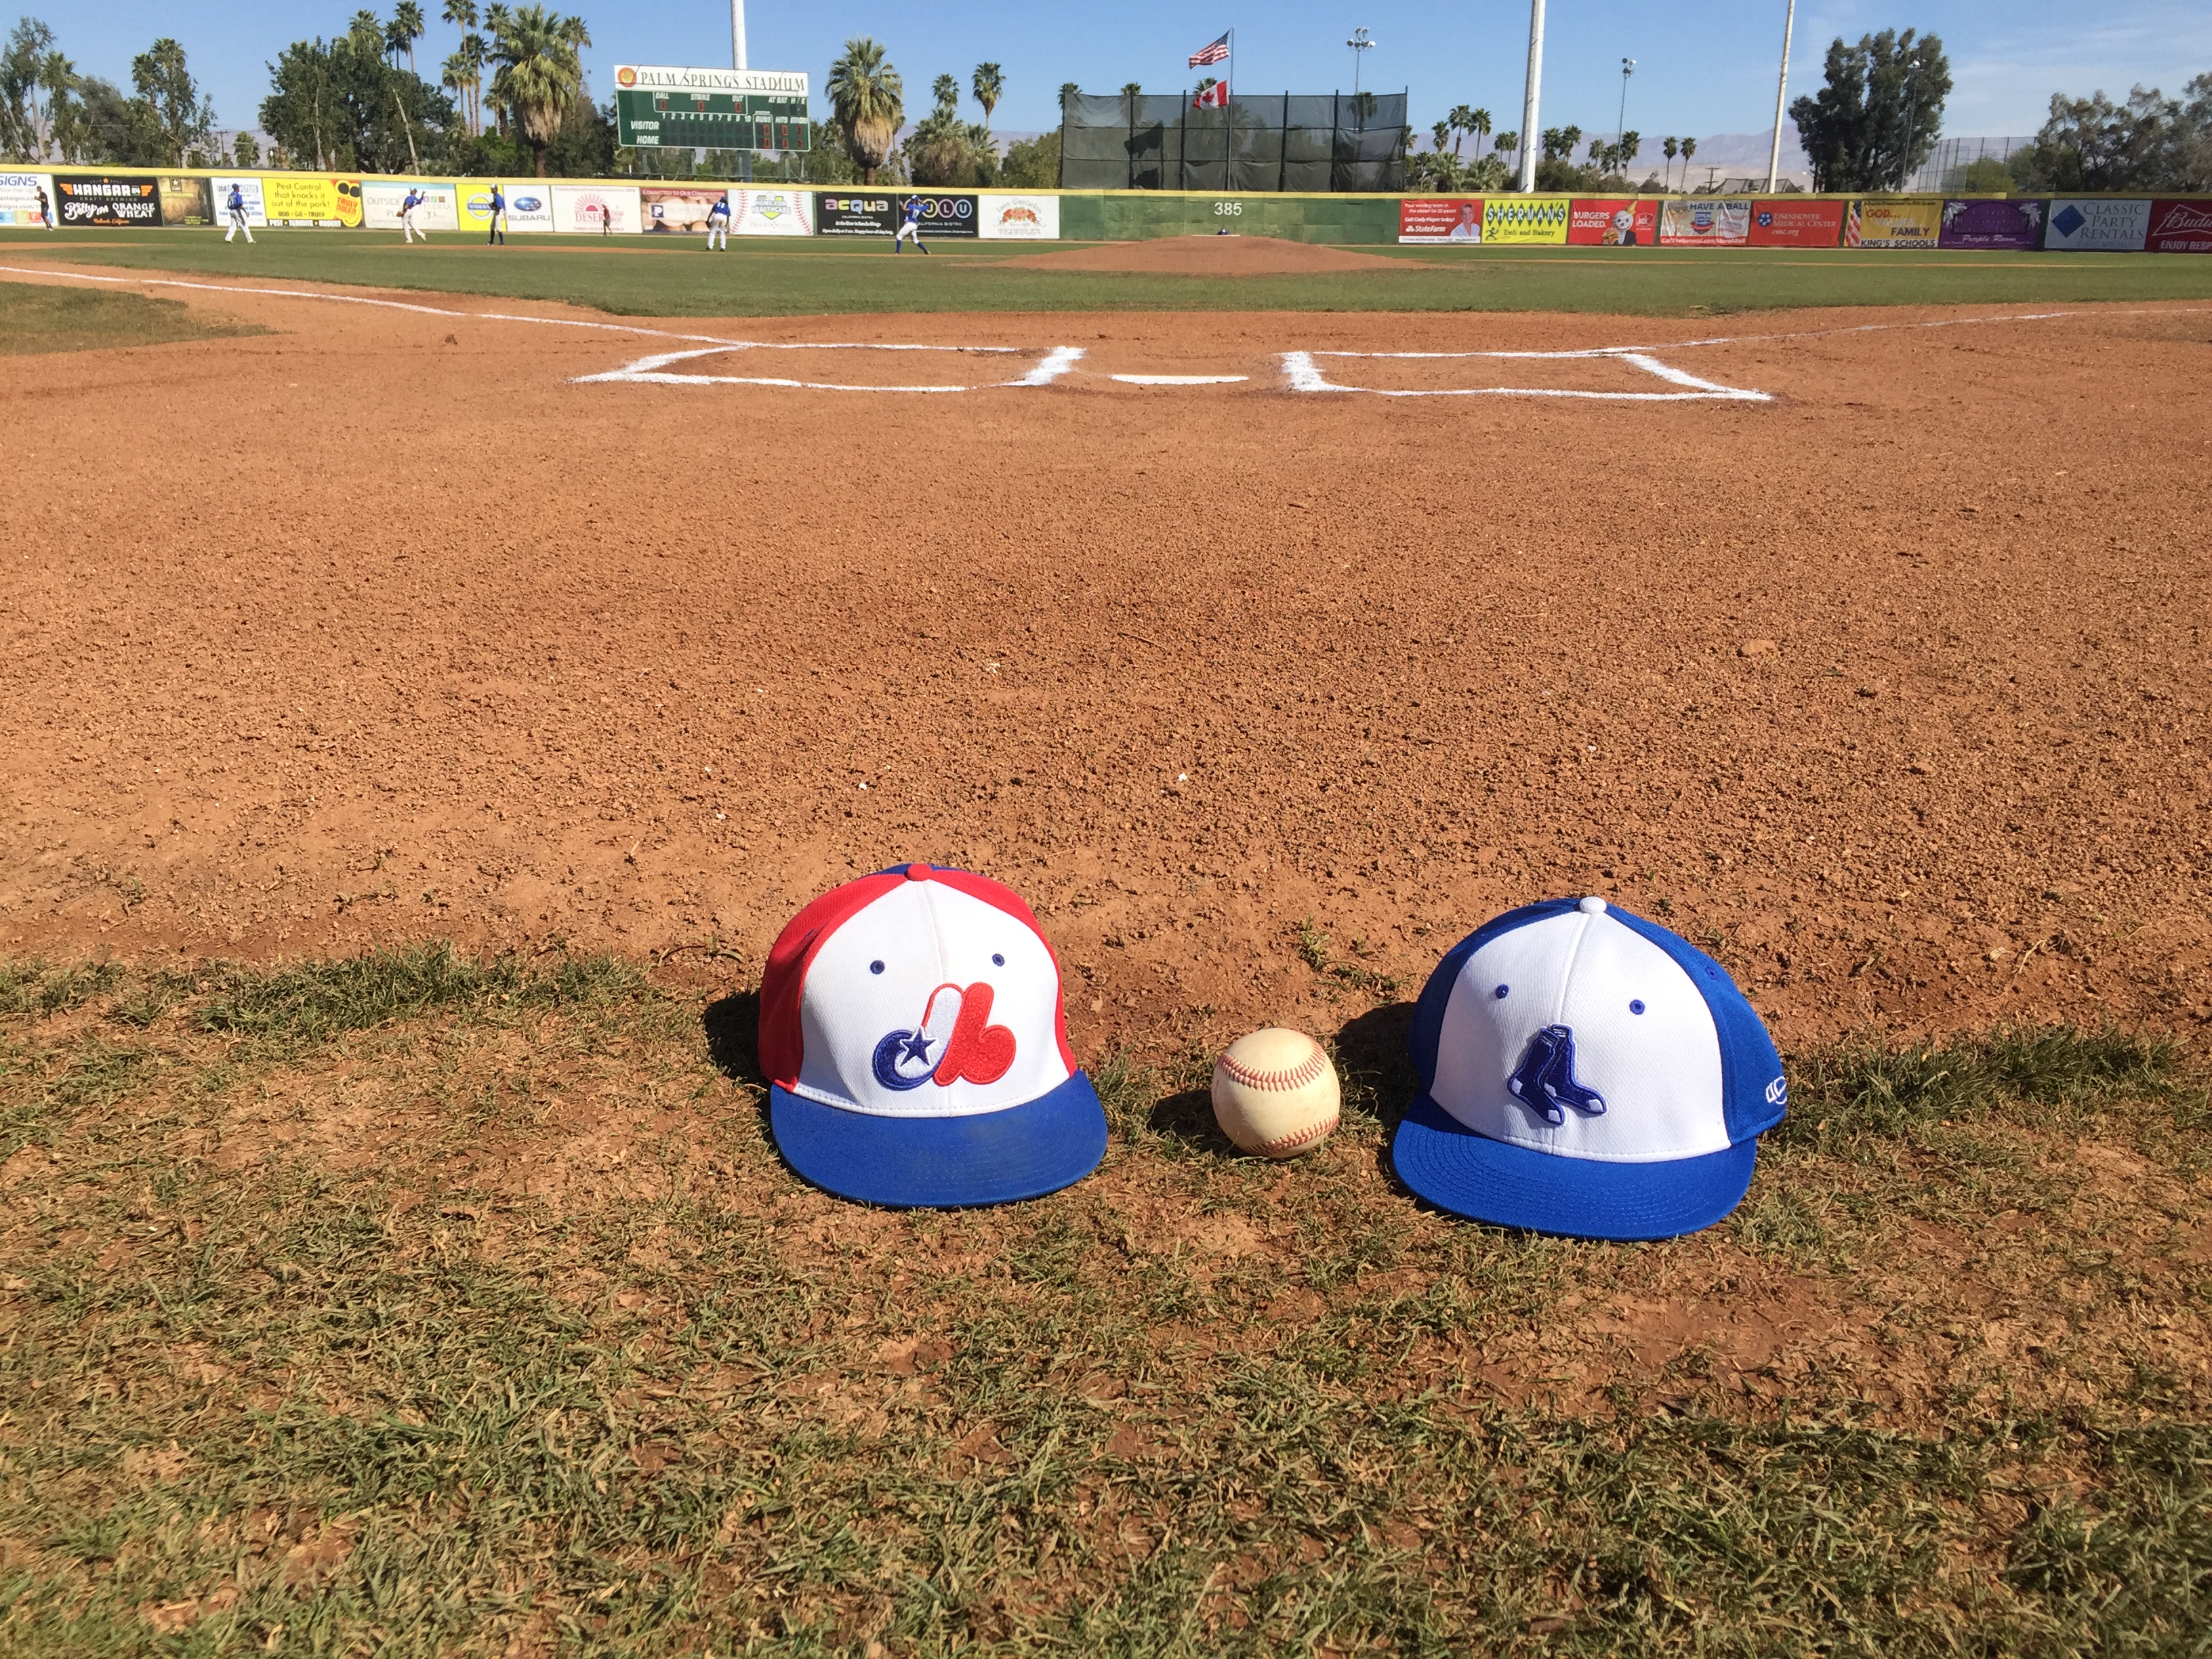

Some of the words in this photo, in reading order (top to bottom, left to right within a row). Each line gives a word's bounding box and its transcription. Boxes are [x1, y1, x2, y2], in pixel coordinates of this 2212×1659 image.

[641, 72, 676, 85] PALM
[683, 74, 739, 88] SPRINGS
[745, 77, 805, 91] STADIUM
[630, 121, 659, 130] VISITOR
[636, 136, 659, 144] HOME
[73, 184, 131, 196] HANGAR
[291, 191, 318, 199] knocks
[285, 199, 294, 207] of
[310, 201, 330, 209] park!
[337, 197, 359, 207] TRULY
[367, 197, 401, 205] OUTSIDE
[64, 202, 97, 220] Betty
[112, 202, 155, 211] ORANGE
[752, 206, 791, 214] HEALTHCARE
[1214, 202, 1243, 216] 385
[2083, 202, 2146, 215] CLASSIC
[575, 212, 605, 222] DESER
[1487, 202, 1565, 222] SHERMAN'S
[1573, 211, 1610, 220] BURGERS
[2092, 216, 2137, 228] PARTY
[1532, 229, 1555, 237] Bakery
[1891, 228, 1931, 236] FAMILY
[2080, 227, 2144, 240] RENTALS
[1861, 239, 1890, 247] KING'S
[1894, 239, 1936, 247] SCHOOLS
[1963, 234, 1990, 243] Purple
[2160, 240, 2188, 250] ENJOY
